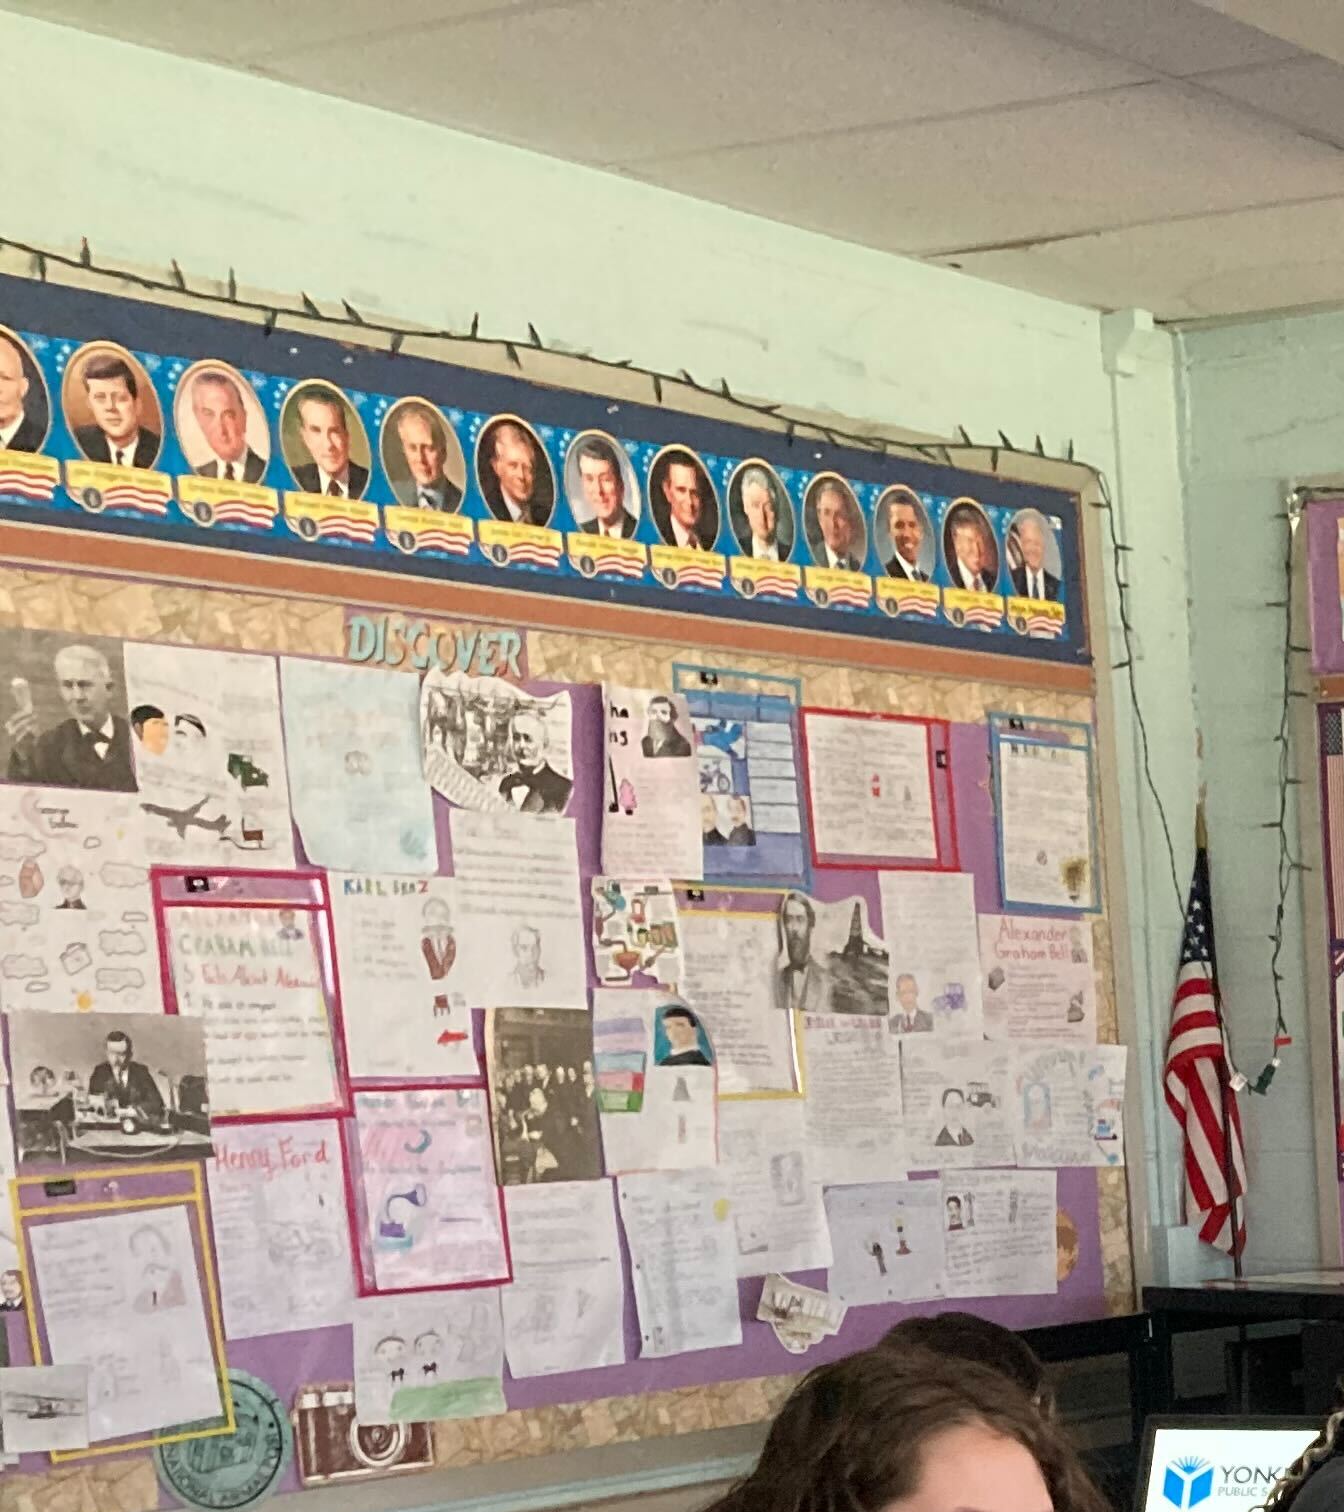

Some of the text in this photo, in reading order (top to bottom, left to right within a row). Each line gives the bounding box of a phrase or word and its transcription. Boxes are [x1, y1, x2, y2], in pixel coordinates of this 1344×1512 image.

[348, 611, 524, 681] DISCOVER
[278, 1135, 330, 1170] Ford
[1218, 1486, 1258, 1497] PUBLIC
